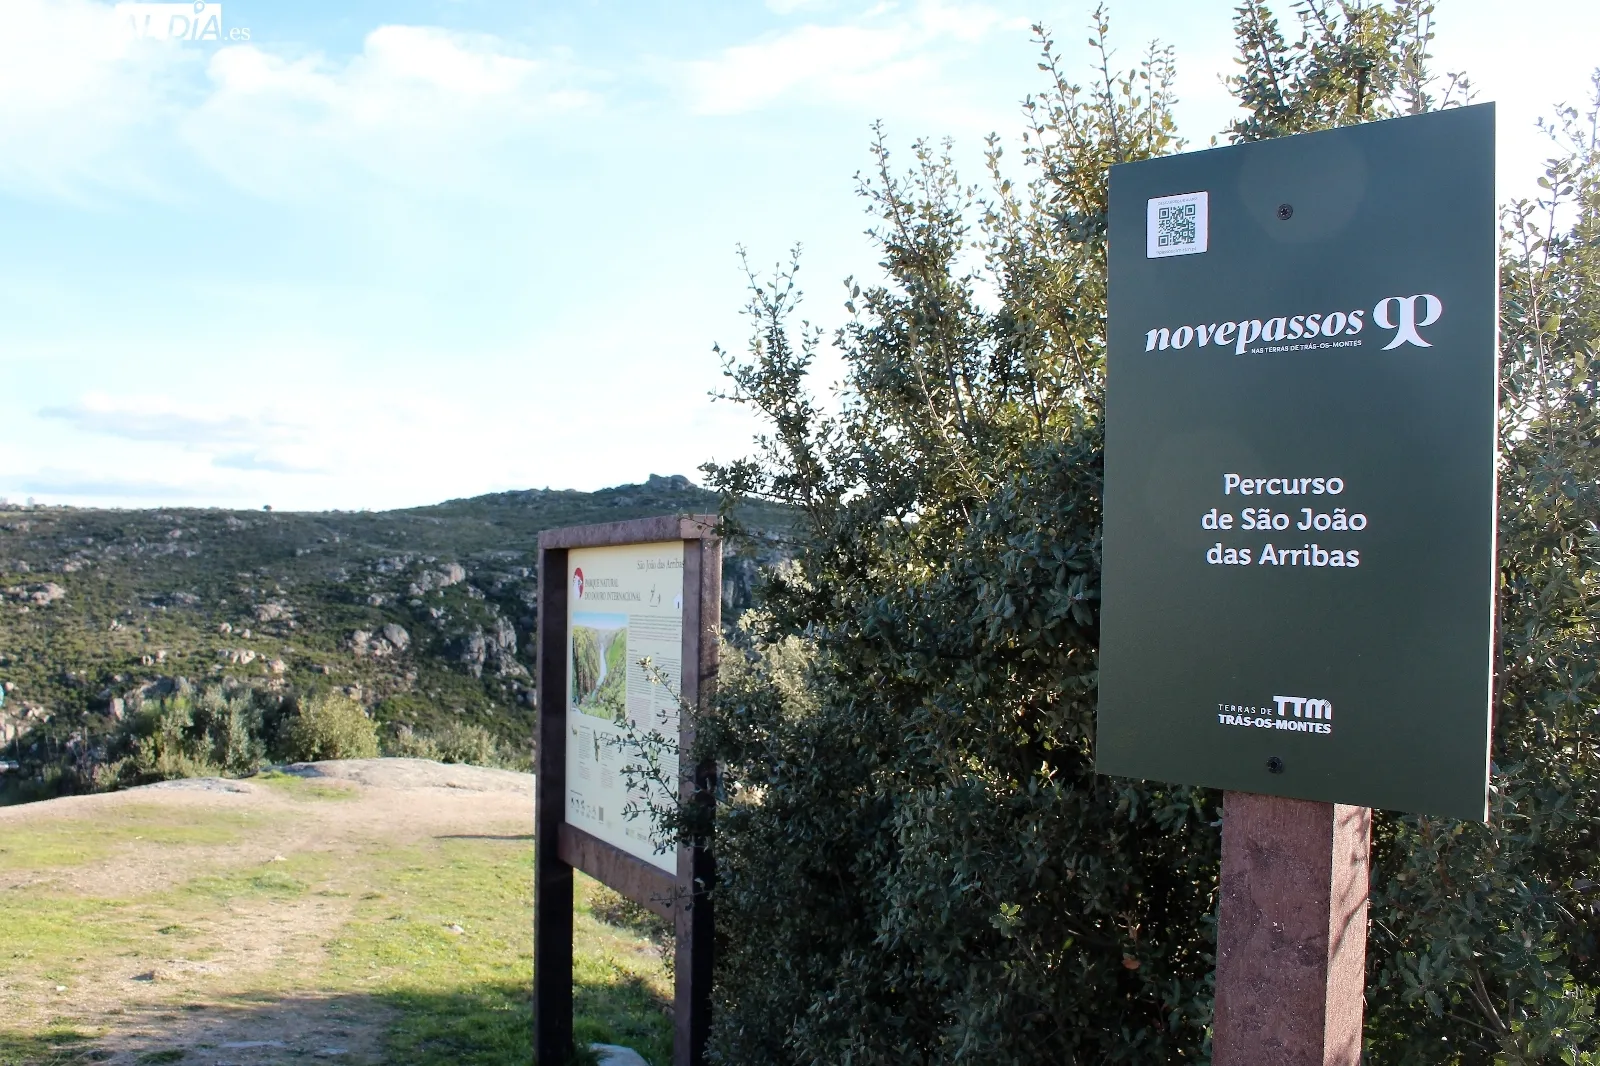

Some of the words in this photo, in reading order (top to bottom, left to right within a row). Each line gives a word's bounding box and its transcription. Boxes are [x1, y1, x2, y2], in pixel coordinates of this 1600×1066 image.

[1144, 309, 1365, 356] novepassos
[1265, 345, 1289, 353] TERRAS
[1300, 339, 1362, 351] TRÁS-OS-MONTES
[1223, 473, 1344, 495] Percurso
[1201, 508, 1233, 530] de
[1241, 507, 1290, 530] São
[1297, 507, 1368, 531] João
[1206, 543, 1252, 566] das
[1258, 543, 1360, 568] Arribas
[1218, 703, 1256, 714] TERRAS
[1260, 707, 1272, 716] DE
[1218, 713, 1331, 734] TRÁS-OS-MONTES
